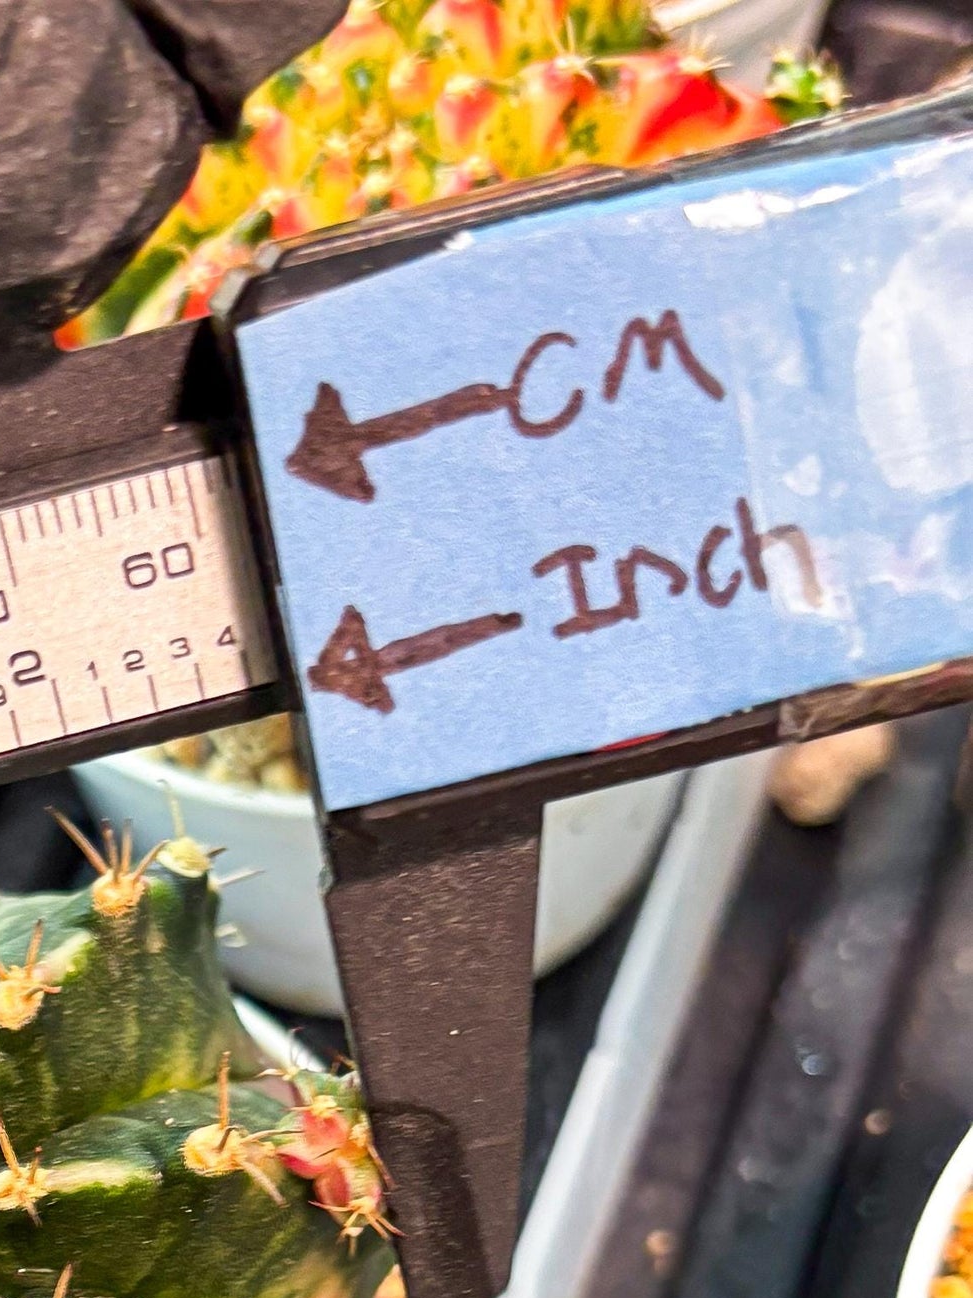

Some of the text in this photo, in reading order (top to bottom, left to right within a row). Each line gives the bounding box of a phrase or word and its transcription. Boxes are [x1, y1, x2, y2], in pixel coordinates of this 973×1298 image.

[506, 308, 726, 440] CM
[121, 541, 195, 590] 60
[532, 496, 827, 640] Inch
[7, 648, 47, 687] 2
[85, 660, 100, 682] 1
[121, 648, 147, 673] 2
[168, 635, 193, 660] 3
[215, 623, 237, 649] 4
